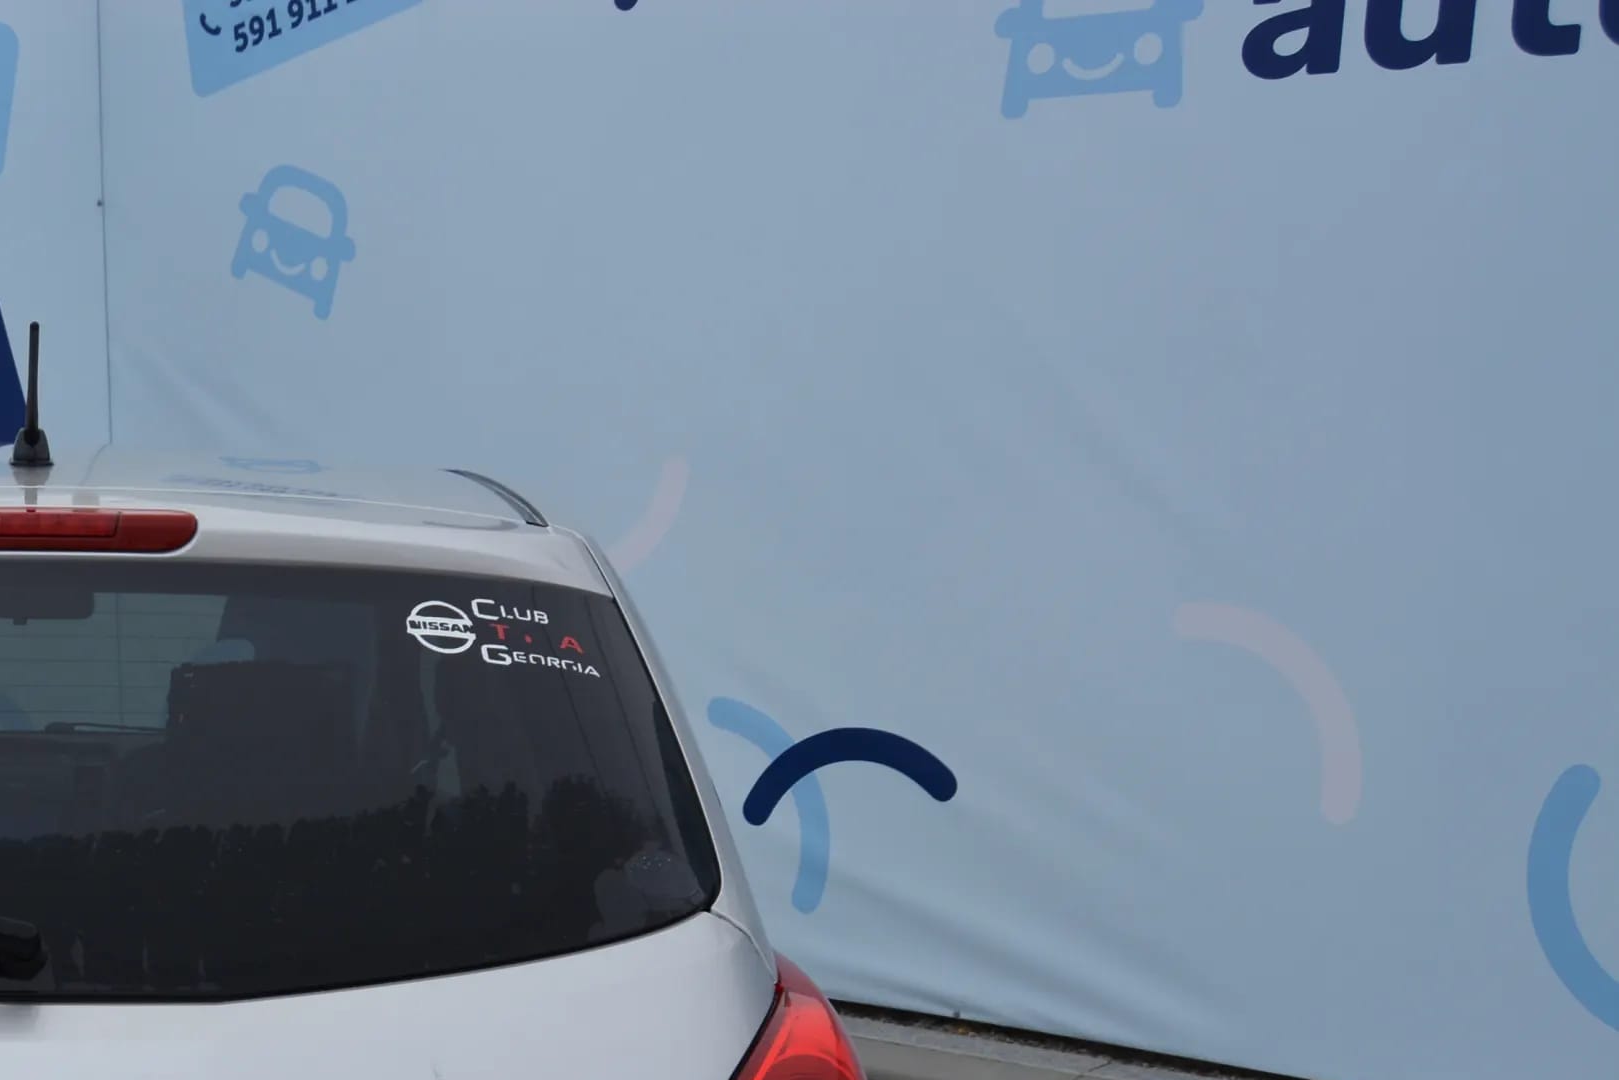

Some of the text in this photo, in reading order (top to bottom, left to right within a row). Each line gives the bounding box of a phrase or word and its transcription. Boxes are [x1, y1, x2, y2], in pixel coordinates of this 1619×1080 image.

[233, 8, 282, 53] 591
[470, 598, 549, 624] CLUB
[408, 618, 475, 635] NISSAN
